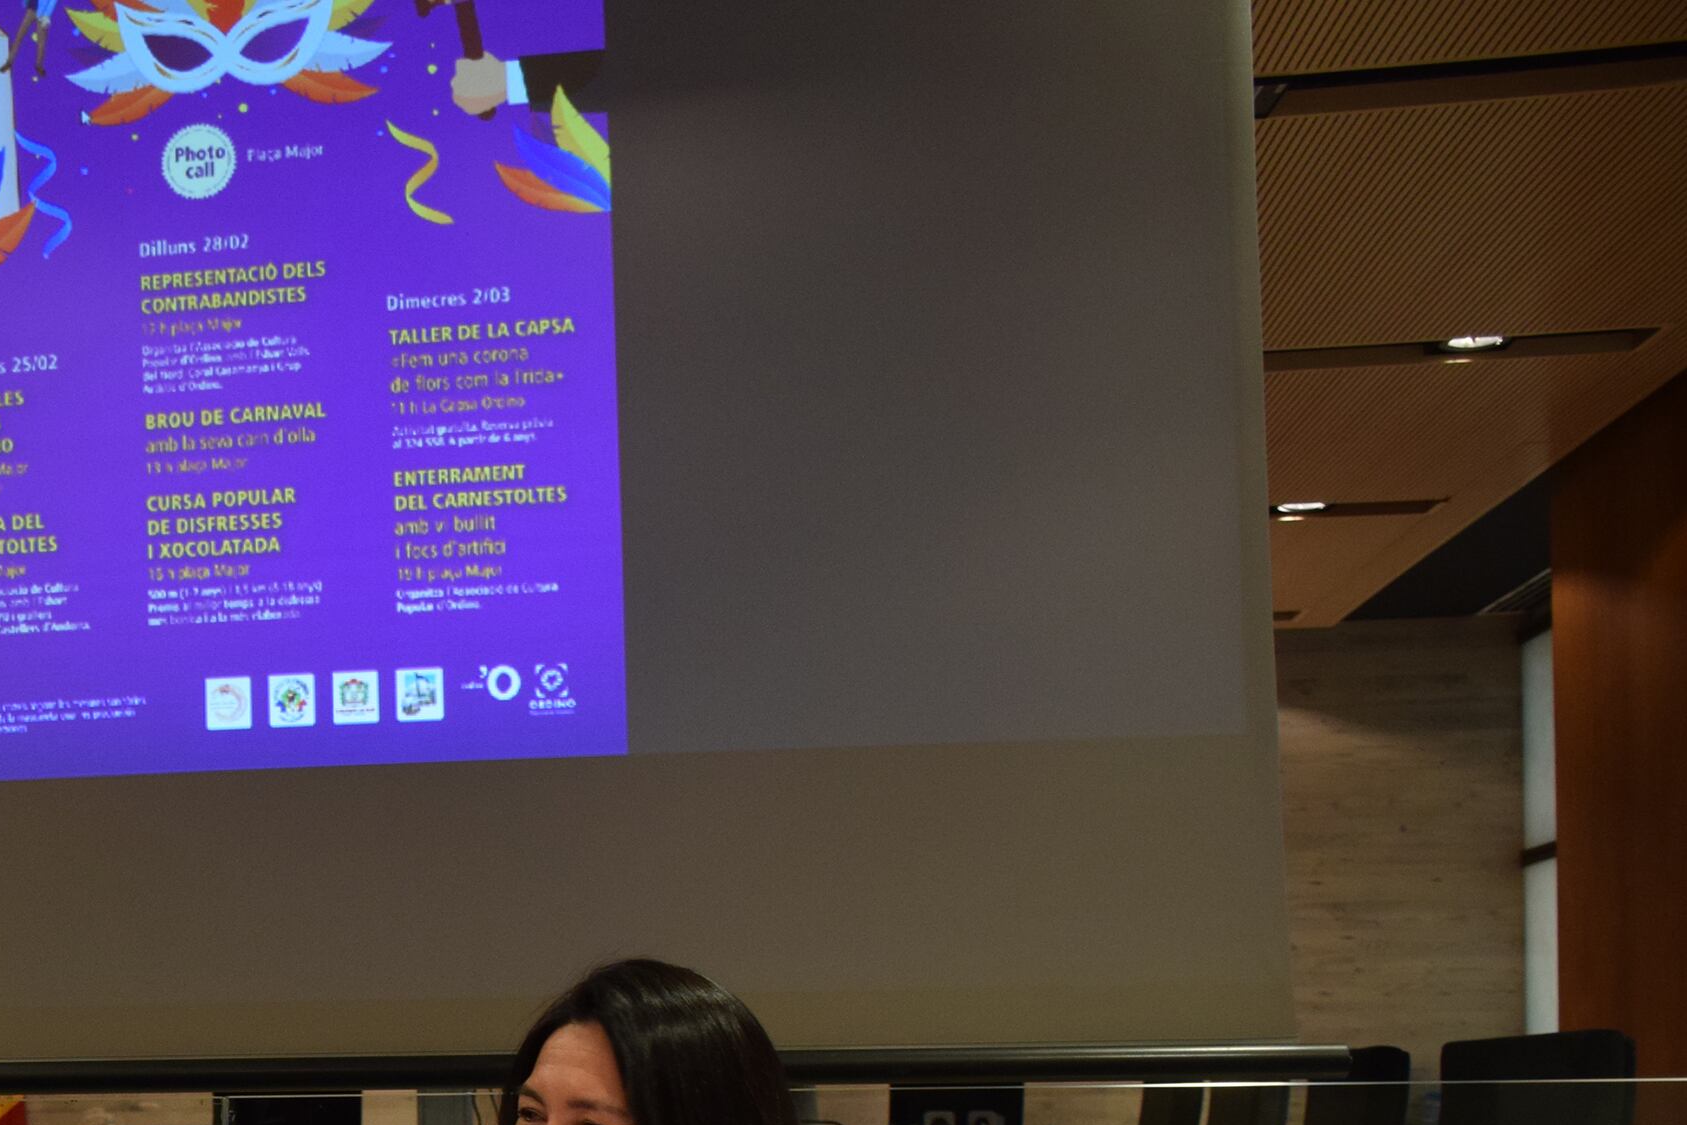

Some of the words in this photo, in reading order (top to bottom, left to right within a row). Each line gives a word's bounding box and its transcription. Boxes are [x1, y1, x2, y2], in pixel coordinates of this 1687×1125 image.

[175, 144, 226, 162] Photo
[185, 162, 215, 180] call
[140, 240, 196, 258] Dilluns
[203, 234, 249, 251] 28/02
[140, 263, 276, 290] REPRESENTACIÓ
[282, 260, 326, 278] DELS
[140, 286, 306, 314] CONTRABANDISTES
[387, 294, 466, 311] Dimecres
[472, 287, 511, 304] 2/03
[389, 328, 453, 345] TALLER
[458, 324, 481, 340] DE
[487, 322, 509, 338] LA
[515, 317, 575, 335] CAPSA
[12, 355, 58, 373] 25/02
[473, 346, 529, 364] corona
[390, 377, 409, 394] de
[416, 375, 450, 391] flors
[456, 374, 488, 389] com
[495, 370, 510, 386] la
[144, 412, 194, 430] BROU
[201, 410, 224, 426] DE
[230, 402, 326, 424] CARNAVAL
[146, 438, 178, 453] amb
[182, 436, 195, 450] la
[200, 435, 233, 449] seva
[393, 464, 525, 487] ENTERRAMENT
[146, 494, 206, 512] CURSA
[212, 488, 296, 508] POPULAR
[394, 495, 427, 512] DEL
[432, 486, 568, 510] CARNESTOLTES
[12, 514, 44, 531] DEL
[147, 520, 170, 536] DE
[176, 512, 282, 534] DISFRESSES
[148, 545, 153, 560] I
[159, 536, 280, 558] XOCOLATADA
[406, 544, 438, 559] focs
